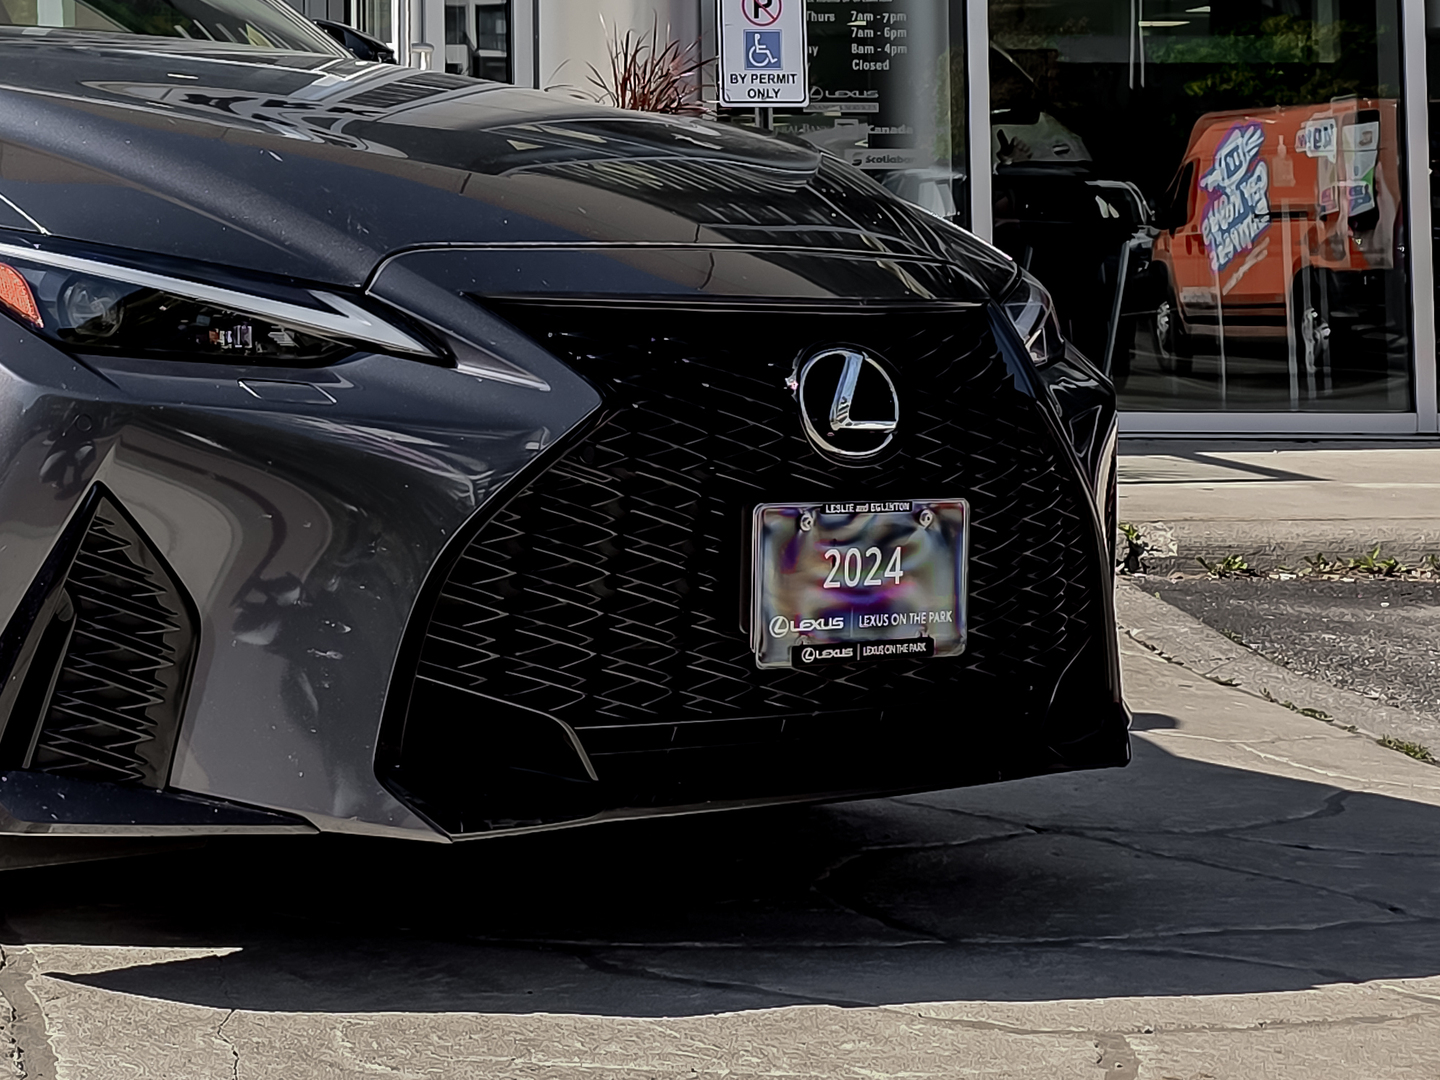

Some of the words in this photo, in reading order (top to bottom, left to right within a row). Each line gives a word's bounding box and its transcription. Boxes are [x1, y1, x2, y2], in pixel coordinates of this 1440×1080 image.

[850, 10, 874, 22] 7am
[883, 12, 907, 25] 7pm
[851, 26, 874, 38] 7am
[883, 26, 907, 41] 6pm
[884, 43, 908, 57] 4pm
[852, 59, 890, 70] Closed
[729, 73, 747, 85] BY
[750, 73, 798, 85] PERMIT
[747, 88, 781, 100] ONLY
[825, 90, 880, 99] LEXUS
[865, 154, 914, 164] Scotiaba
[825, 504, 855, 514] LESLIE
[856, 503, 869, 513] and
[870, 502, 910, 512] EGLINTON
[823, 546, 904, 589] 2024
[790, 617, 845, 632] LEXUS
[859, 614, 889, 628] LEXUS
[890, 613, 908, 626] ON
[909, 612, 927, 625] THE
[929, 610, 953, 624] PARK
[815, 648, 854, 658] LEXUS
[863, 645, 884, 656] LEXUS
[884, 644, 896, 655] ON
[896, 643, 909, 654] THE
[909, 642, 927, 653] PARK
